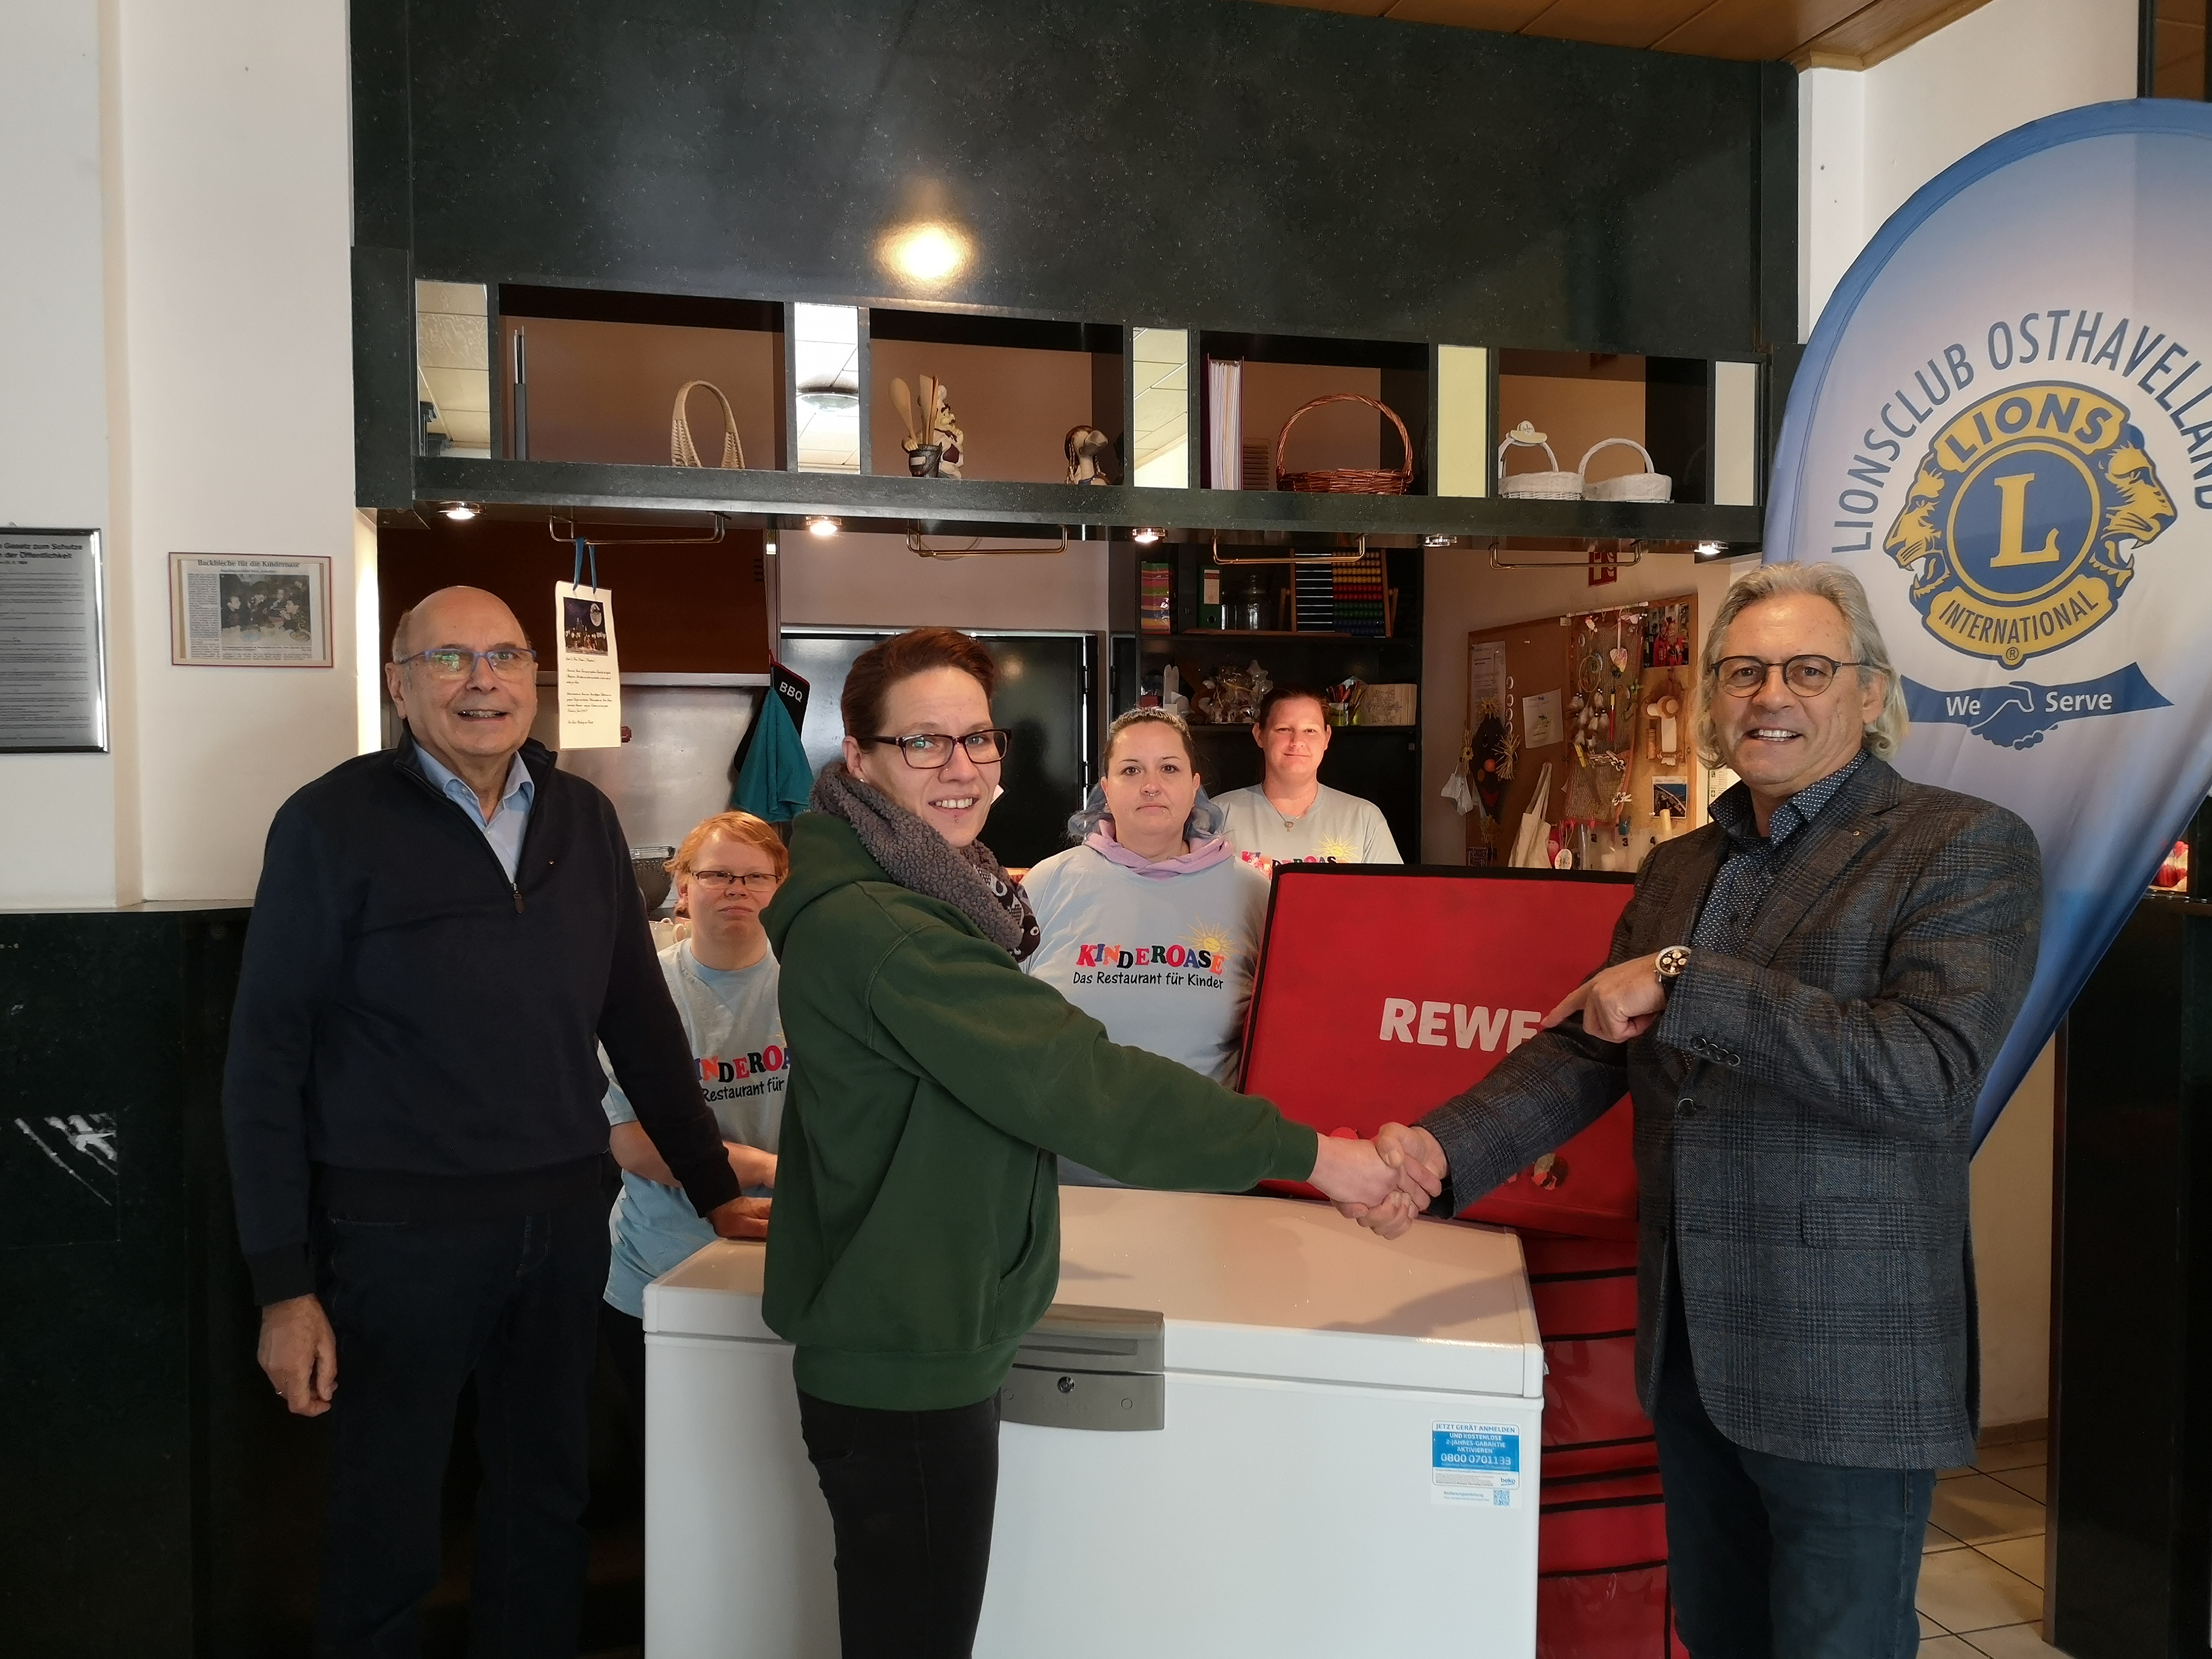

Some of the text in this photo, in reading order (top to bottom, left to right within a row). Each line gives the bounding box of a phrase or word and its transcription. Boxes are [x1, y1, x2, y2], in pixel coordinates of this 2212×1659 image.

[1945, 392, 2114, 464] LIONS
[1831, 343, 1974, 553] LIONSCLUB
[1989, 472, 2060, 569] L
[1939, 590, 2099, 645] INTERNATIONAL
[779, 681, 803, 703] BBQ
[1946, 691, 2113, 716] We Serve
[1075, 943, 1225, 975] KINDEROASE
[1073, 971, 1224, 990] Das Restaurant für Kinder
[1379, 997, 1541, 1054] REWE
[694, 1045, 793, 1083] INDEROA
[702, 1076, 785, 1102] Restaurant für
[1441, 1453, 1511, 1466] 0800 0701133
